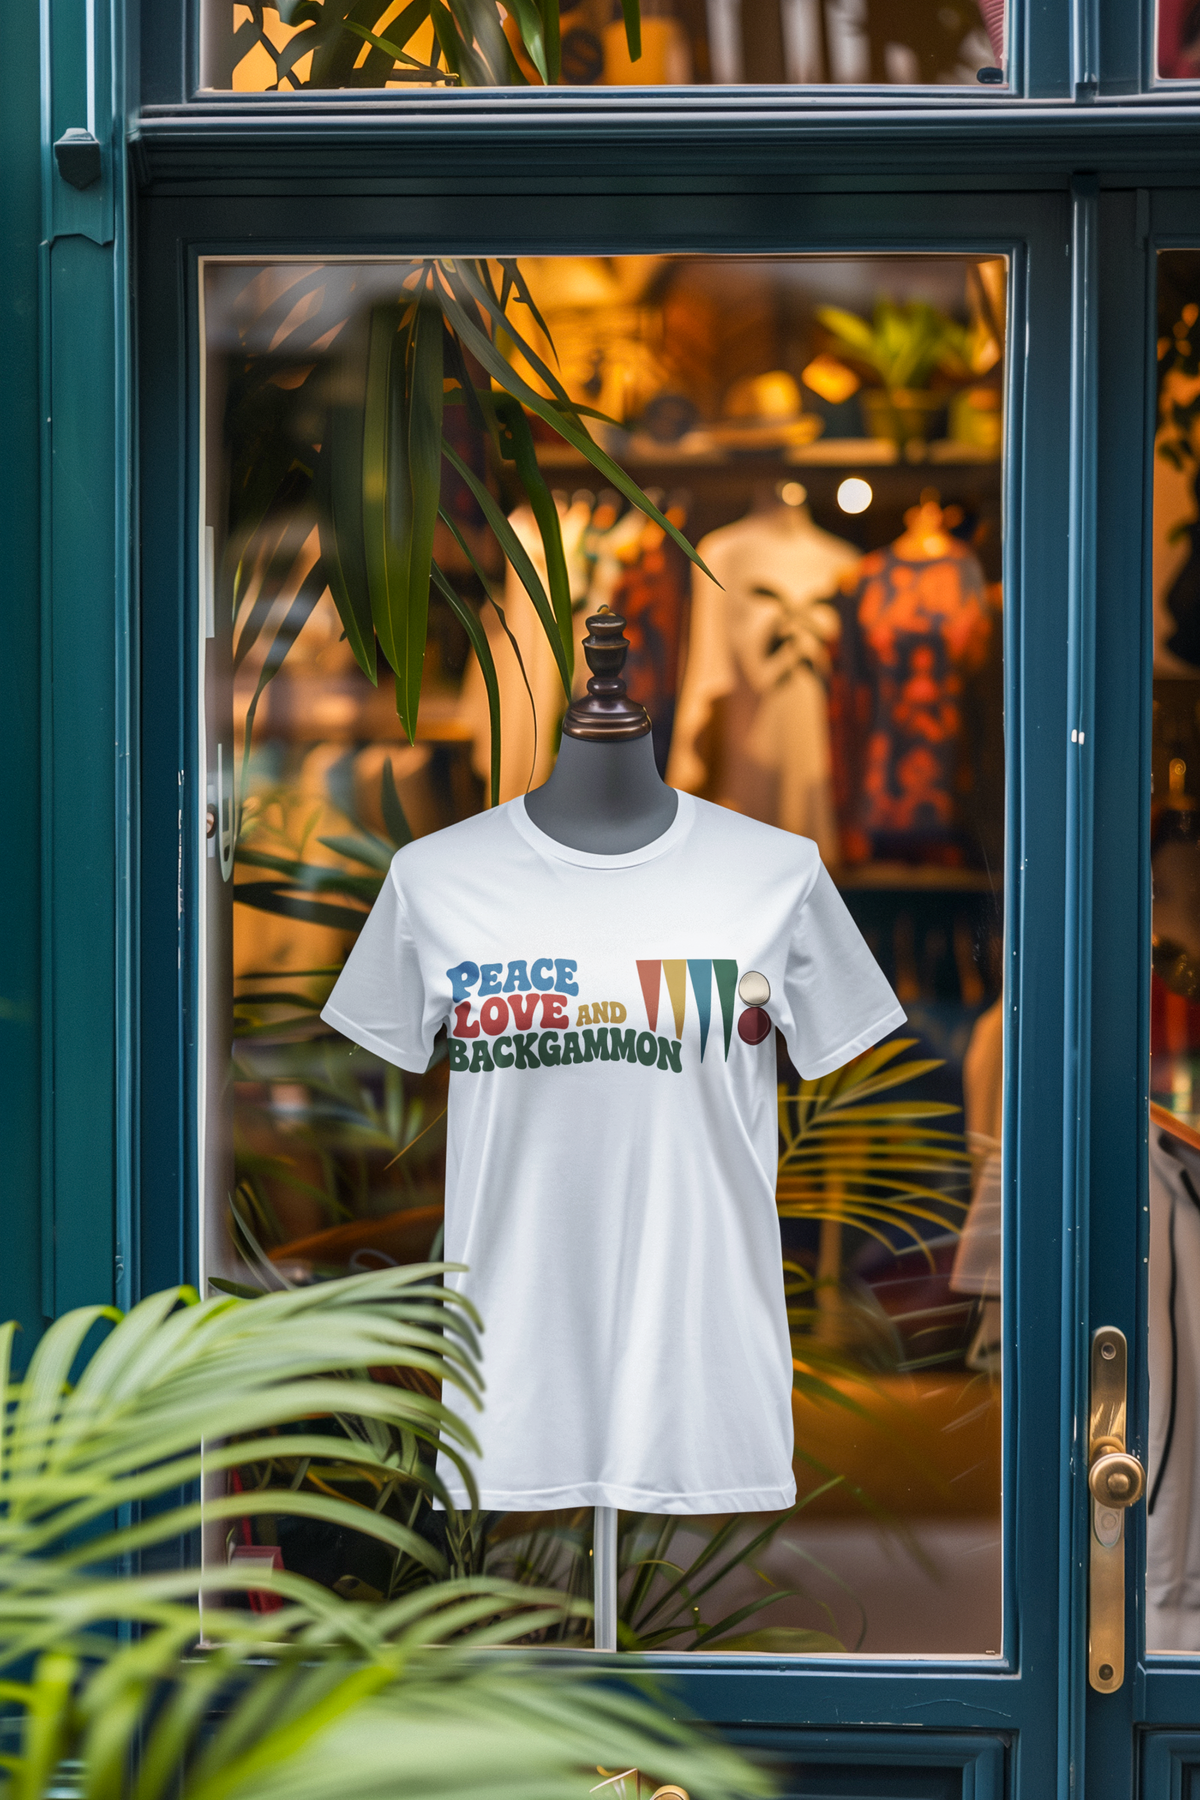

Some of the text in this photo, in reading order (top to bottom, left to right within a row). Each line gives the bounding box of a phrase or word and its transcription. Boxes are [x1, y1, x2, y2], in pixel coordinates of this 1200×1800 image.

[446, 958, 579, 1003] PEACE
[453, 993, 627, 1038] LOVE AND
[448, 1027, 683, 1073] BACKGAMMON
